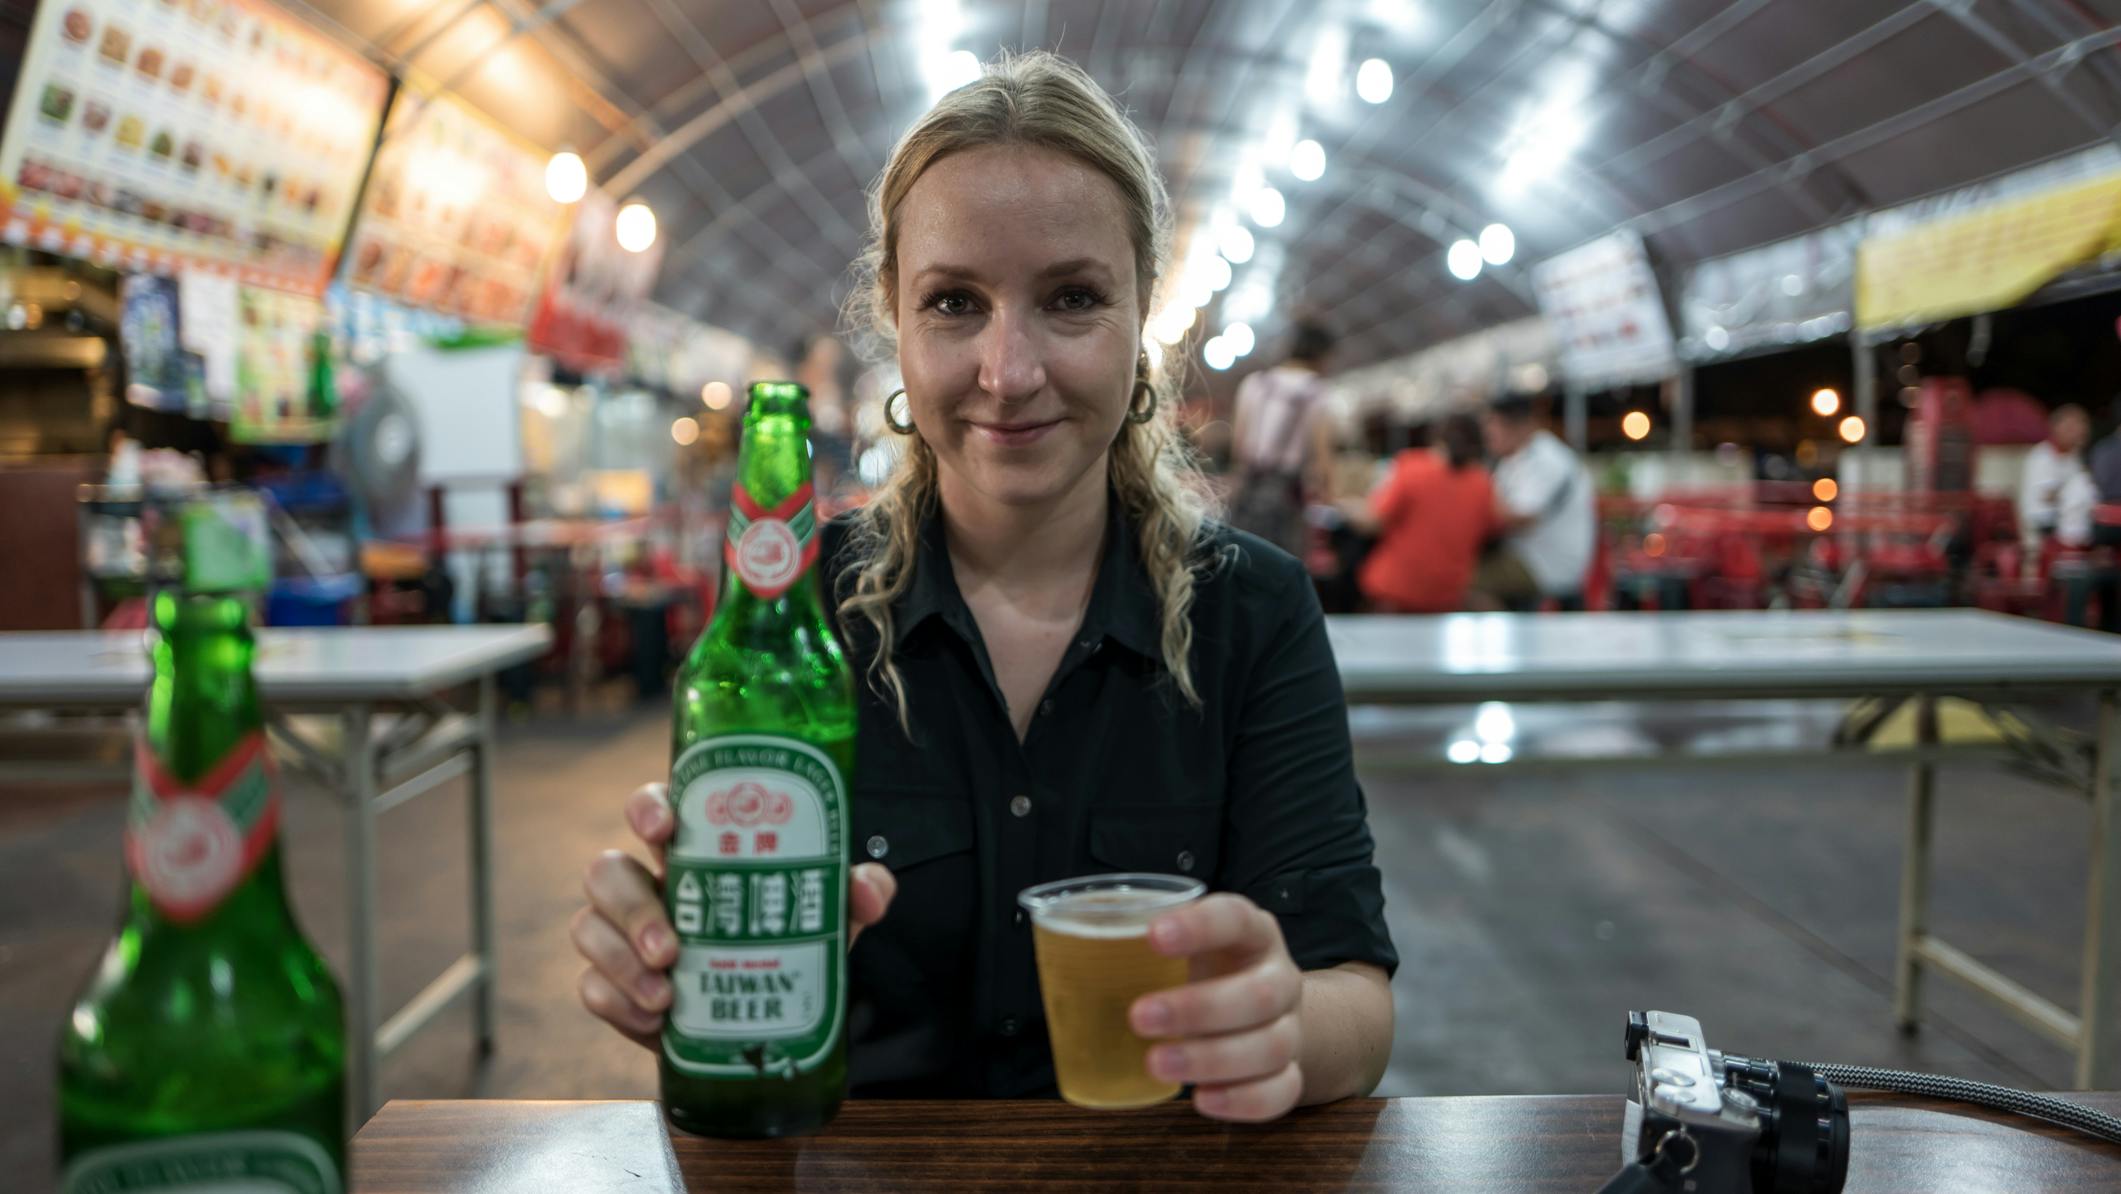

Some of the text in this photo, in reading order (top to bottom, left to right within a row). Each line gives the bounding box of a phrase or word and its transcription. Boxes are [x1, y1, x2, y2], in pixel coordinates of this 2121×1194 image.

[714, 749, 790, 769] FLAVOR
[700, 971, 796, 995] TAIWAN
[710, 996, 784, 1021] BEER
